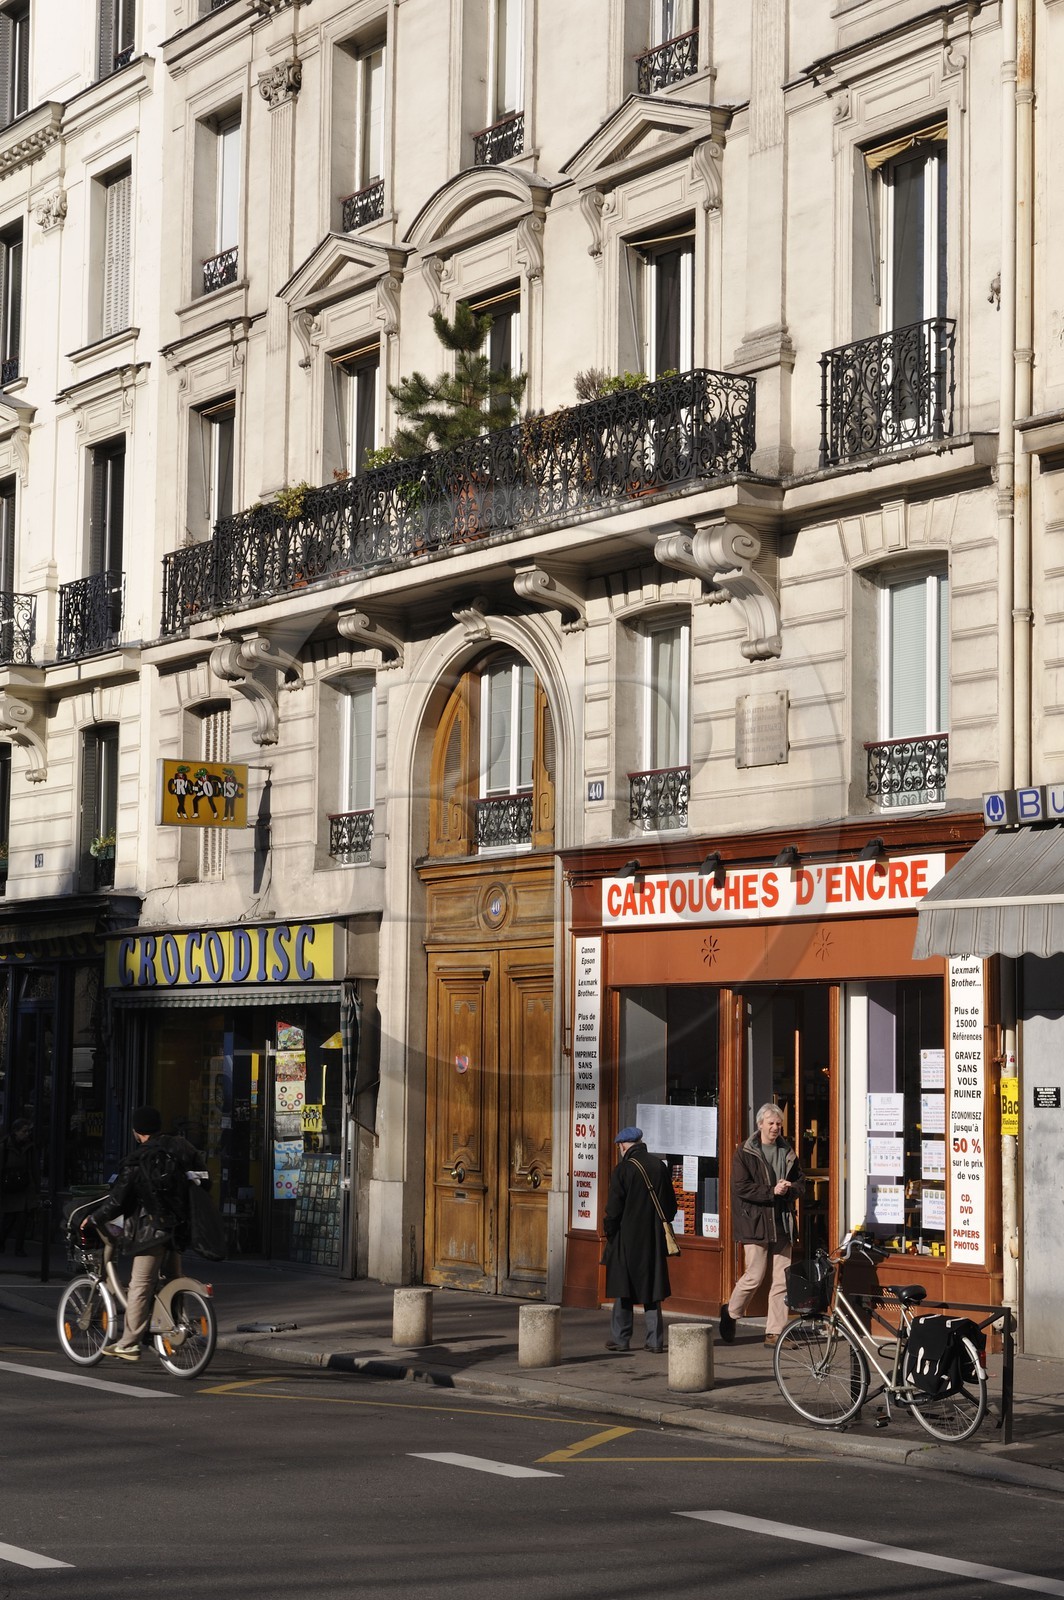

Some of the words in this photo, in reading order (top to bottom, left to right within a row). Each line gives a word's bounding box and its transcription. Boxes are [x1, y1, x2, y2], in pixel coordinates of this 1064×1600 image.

[589, 782, 602, 799] 40
[607, 872, 779, 917] CARTOUCHES
[796, 860, 928, 906] D'ENCRE
[491, 900, 500, 913] 40
[581, 946, 596, 954] Canon
[119, 924, 315, 986] CROCODISC
[581, 957, 595, 966] Epson
[951, 965, 980, 975] Lexmark
[578, 979, 598, 987] Lexmark
[954, 1006, 969, 1015] Plus
[970, 1006, 979, 1015] de
[578, 1013, 588, 1021] Plus
[589, 1012, 596, 1020] de
[579, 1023, 594, 1032] 15000
[955, 1019, 977, 1028] 15000
[575, 1051, 597, 1059] IMPRIMEZ
[954, 1051, 981, 1060] GRAVEZ
[957, 1064, 978, 1073] SANS
[578, 1072, 593, 1080] VOUS
[957, 1077, 978, 1086] VOUS
[576, 1082, 595, 1091] RUINER
[953, 1089, 982, 1099] RUINER
[951, 1111, 982, 1120] ECONOMISEZ
[575, 1124, 586, 1137] 50
[589, 1124, 596, 1138] %
[953, 1122, 979, 1133] jusqu'à
[587, 1142, 597, 1150] prix
[952, 1138, 968, 1153] 50
[971, 1138, 981, 1154] %
[577, 1152, 584, 1160] de
[952, 1159, 962, 1167] sur
[963, 1158, 970, 1167] le
[970, 1159, 983, 1169] prix
[574, 1170, 596, 1179] CARTOUCHES
[957, 1171, 966, 1180] de
[967, 1173, 980, 1181] vos
[960, 1194, 972, 1204] CD,
[577, 1209, 590, 1218] TONER
[959, 1205, 973, 1215] DVD
[962, 1218, 970, 1226] et
[953, 1228, 980, 1239] PAPIERS
[953, 1240, 979, 1251] PHOTOS
